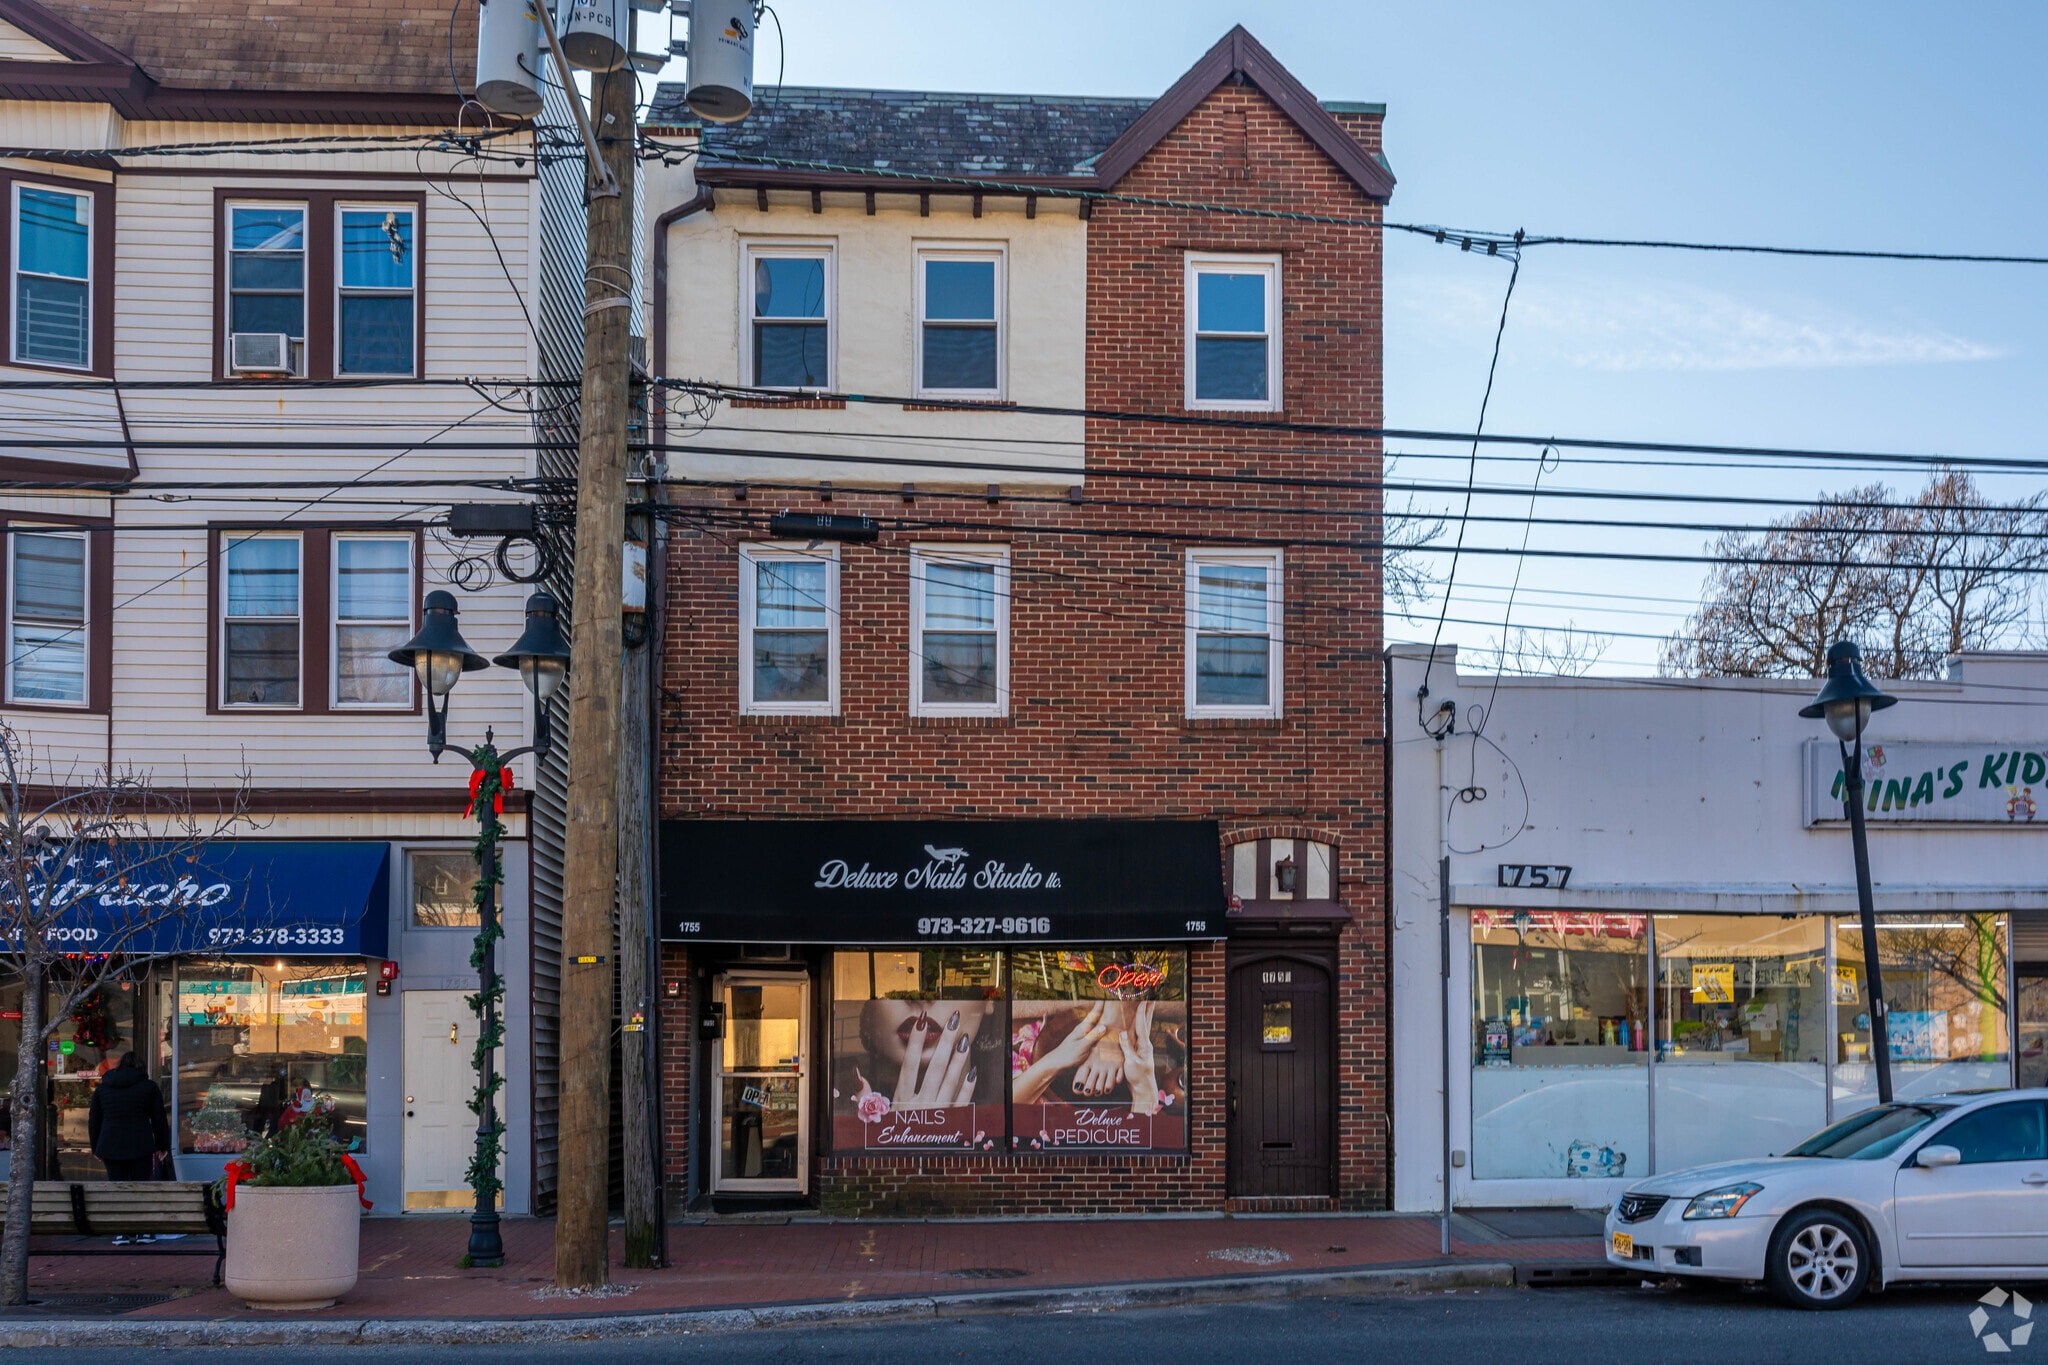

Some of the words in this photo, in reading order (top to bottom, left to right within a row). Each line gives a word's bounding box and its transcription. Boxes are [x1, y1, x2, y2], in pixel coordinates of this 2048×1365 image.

[1979, 751, 2048, 789] KID
[814, 858, 897, 889] Deluxe
[904, 859, 967, 889] Nails
[973, 859, 1042, 889] Studio
[1498, 863, 1572, 889] 1757
[47, 927, 98, 941] FOOD
[679, 921, 700, 933] 1755
[917, 917, 1051, 935] 973-327-9616
[1185, 920, 1206, 932] 1755
[208, 927, 345, 945] 973-378-3333
[1097, 964, 1163, 989] Open
[894, 1109, 946, 1126] NAILS
[1074, 1108, 1123, 1129] Deluxe
[877, 1125, 961, 1144] Enhancement
[1054, 1128, 1141, 1145] PEDICURE
